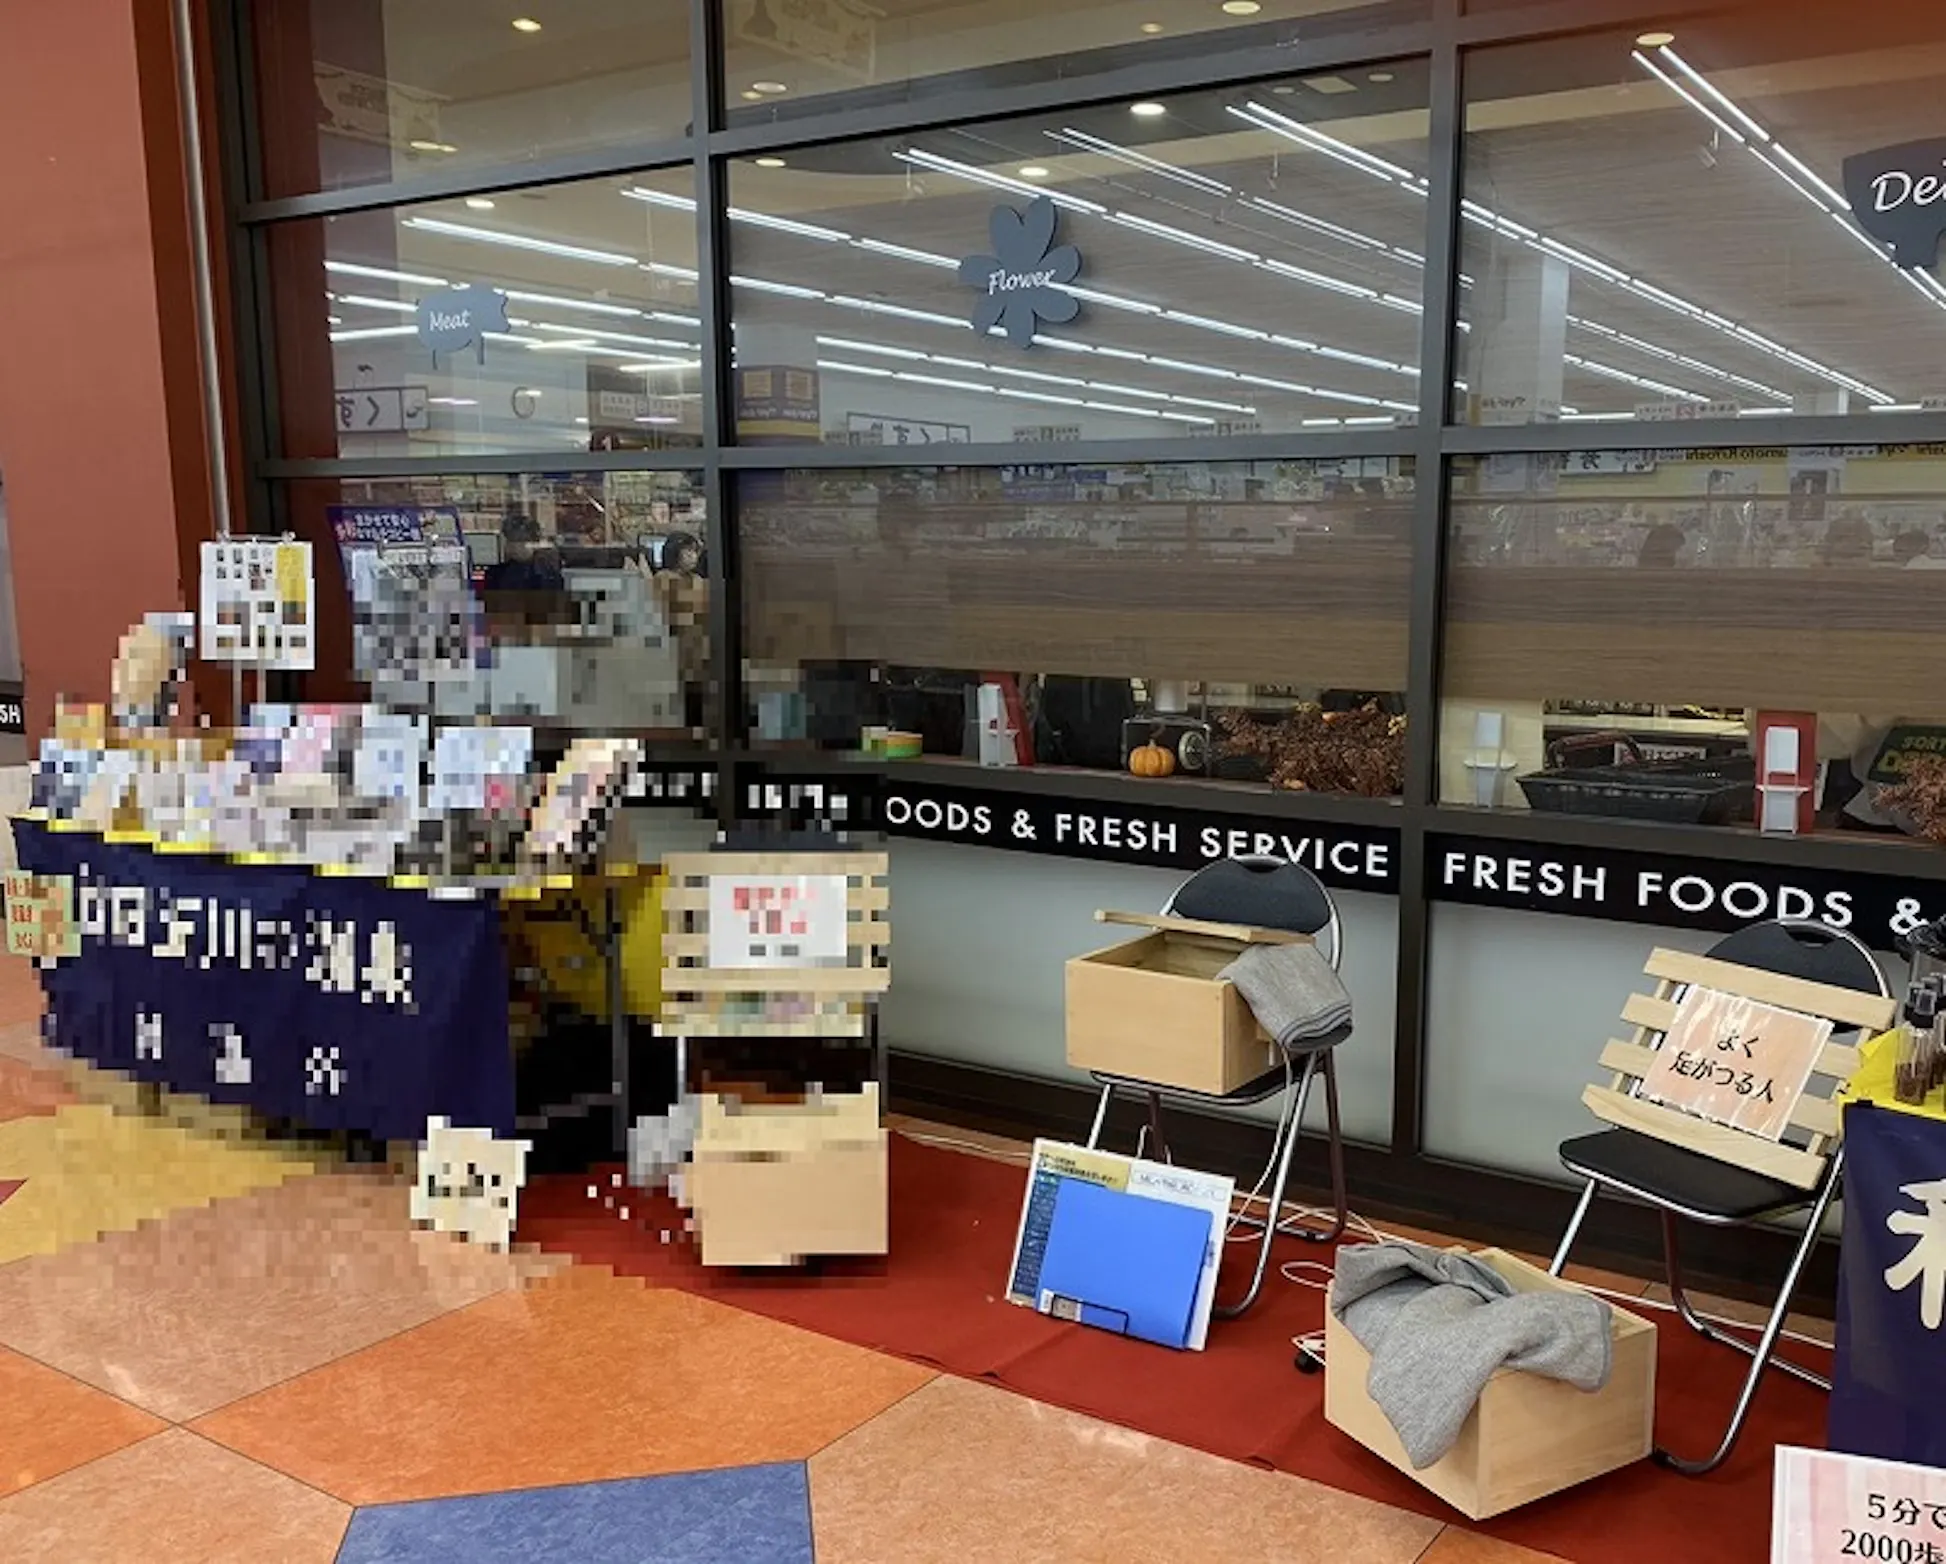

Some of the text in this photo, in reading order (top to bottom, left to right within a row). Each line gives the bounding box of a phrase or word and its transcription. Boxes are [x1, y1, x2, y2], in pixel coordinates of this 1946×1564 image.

[1871, 158, 1946, 212] De
[989, 269, 1055, 295] Flower
[429, 310, 470, 332] Meat
[886, 796, 992, 835] OODS
[1011, 808, 1037, 840] &
[1055, 813, 1177, 853] FRESH
[1200, 827, 1389, 878] SERVICE
[1444, 852, 1930, 937] FRESH FOODS &
[1717, 1029, 1759, 1059] よく
[1669, 1050, 1774, 1105] 足がつる人
